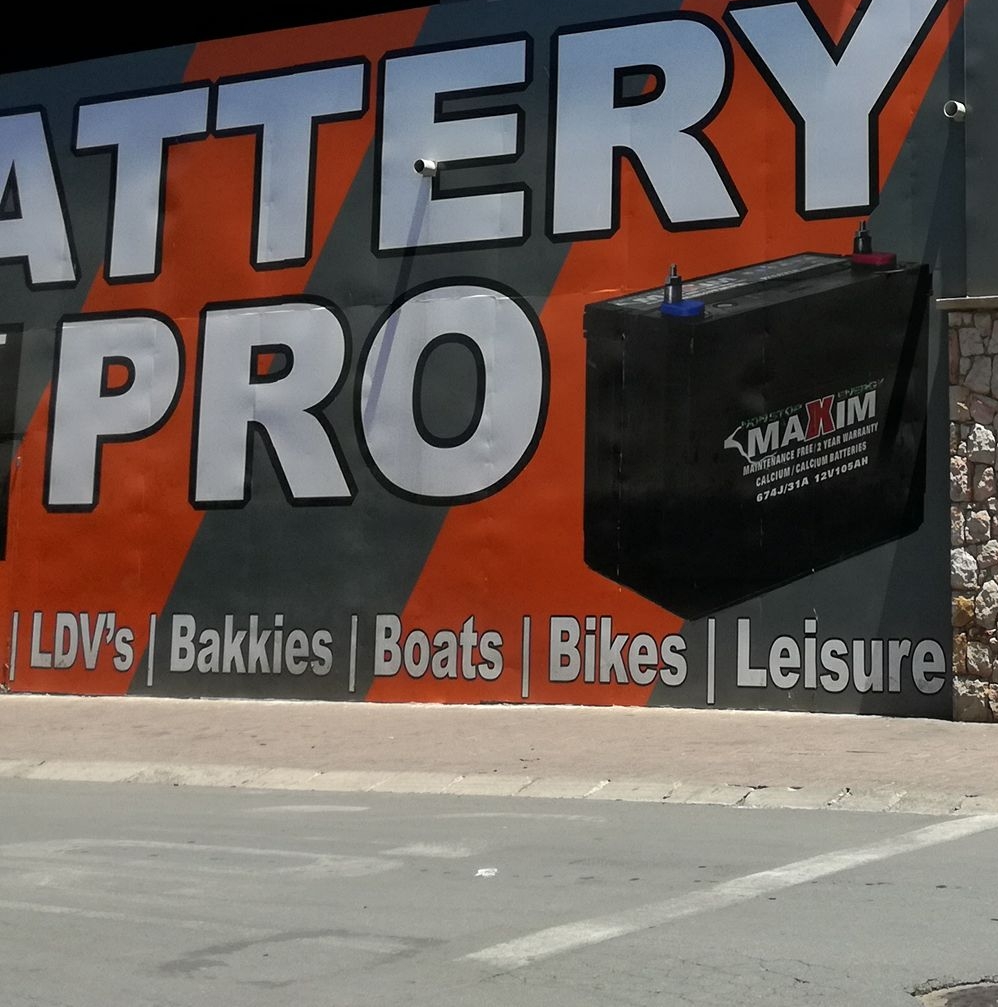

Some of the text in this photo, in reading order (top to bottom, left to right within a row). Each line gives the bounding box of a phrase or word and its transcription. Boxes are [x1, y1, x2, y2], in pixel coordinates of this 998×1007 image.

[44, 278, 548, 511] PRO
[747, 390, 877, 458] MAXIM
[742, 449, 796, 476] MAINTENANCE
[822, 435, 842, 451] YEAR
[842, 421, 879, 446] WARRANTY
[813, 455, 869, 484] 12V105AH
[829, 441, 868, 463] BATTERIES
[29, 610, 948, 695] LDV's Bakkies Boats Bikes Leisure
